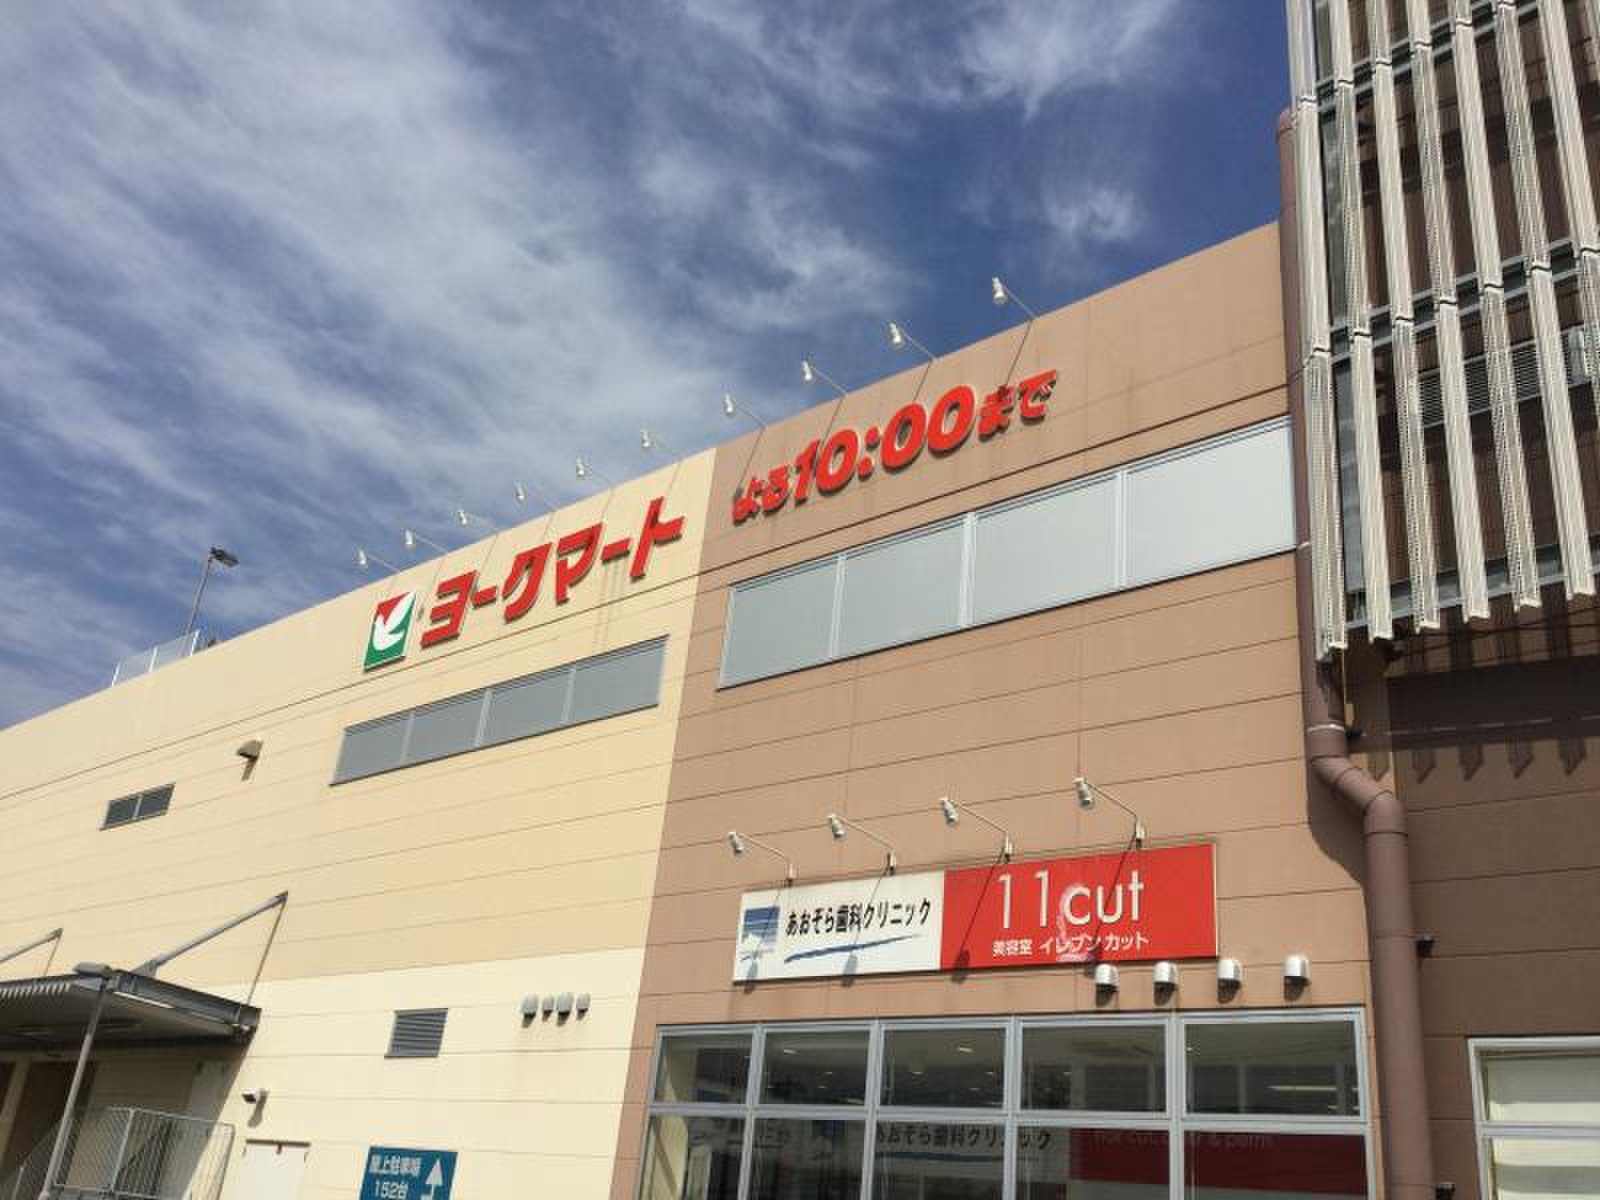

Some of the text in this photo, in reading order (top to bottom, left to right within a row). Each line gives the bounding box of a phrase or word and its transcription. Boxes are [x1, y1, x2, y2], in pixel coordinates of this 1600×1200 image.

[421, 496, 685, 648] ヨークマート
[785, 898, 931, 936] あおぞら歯科クリニック
